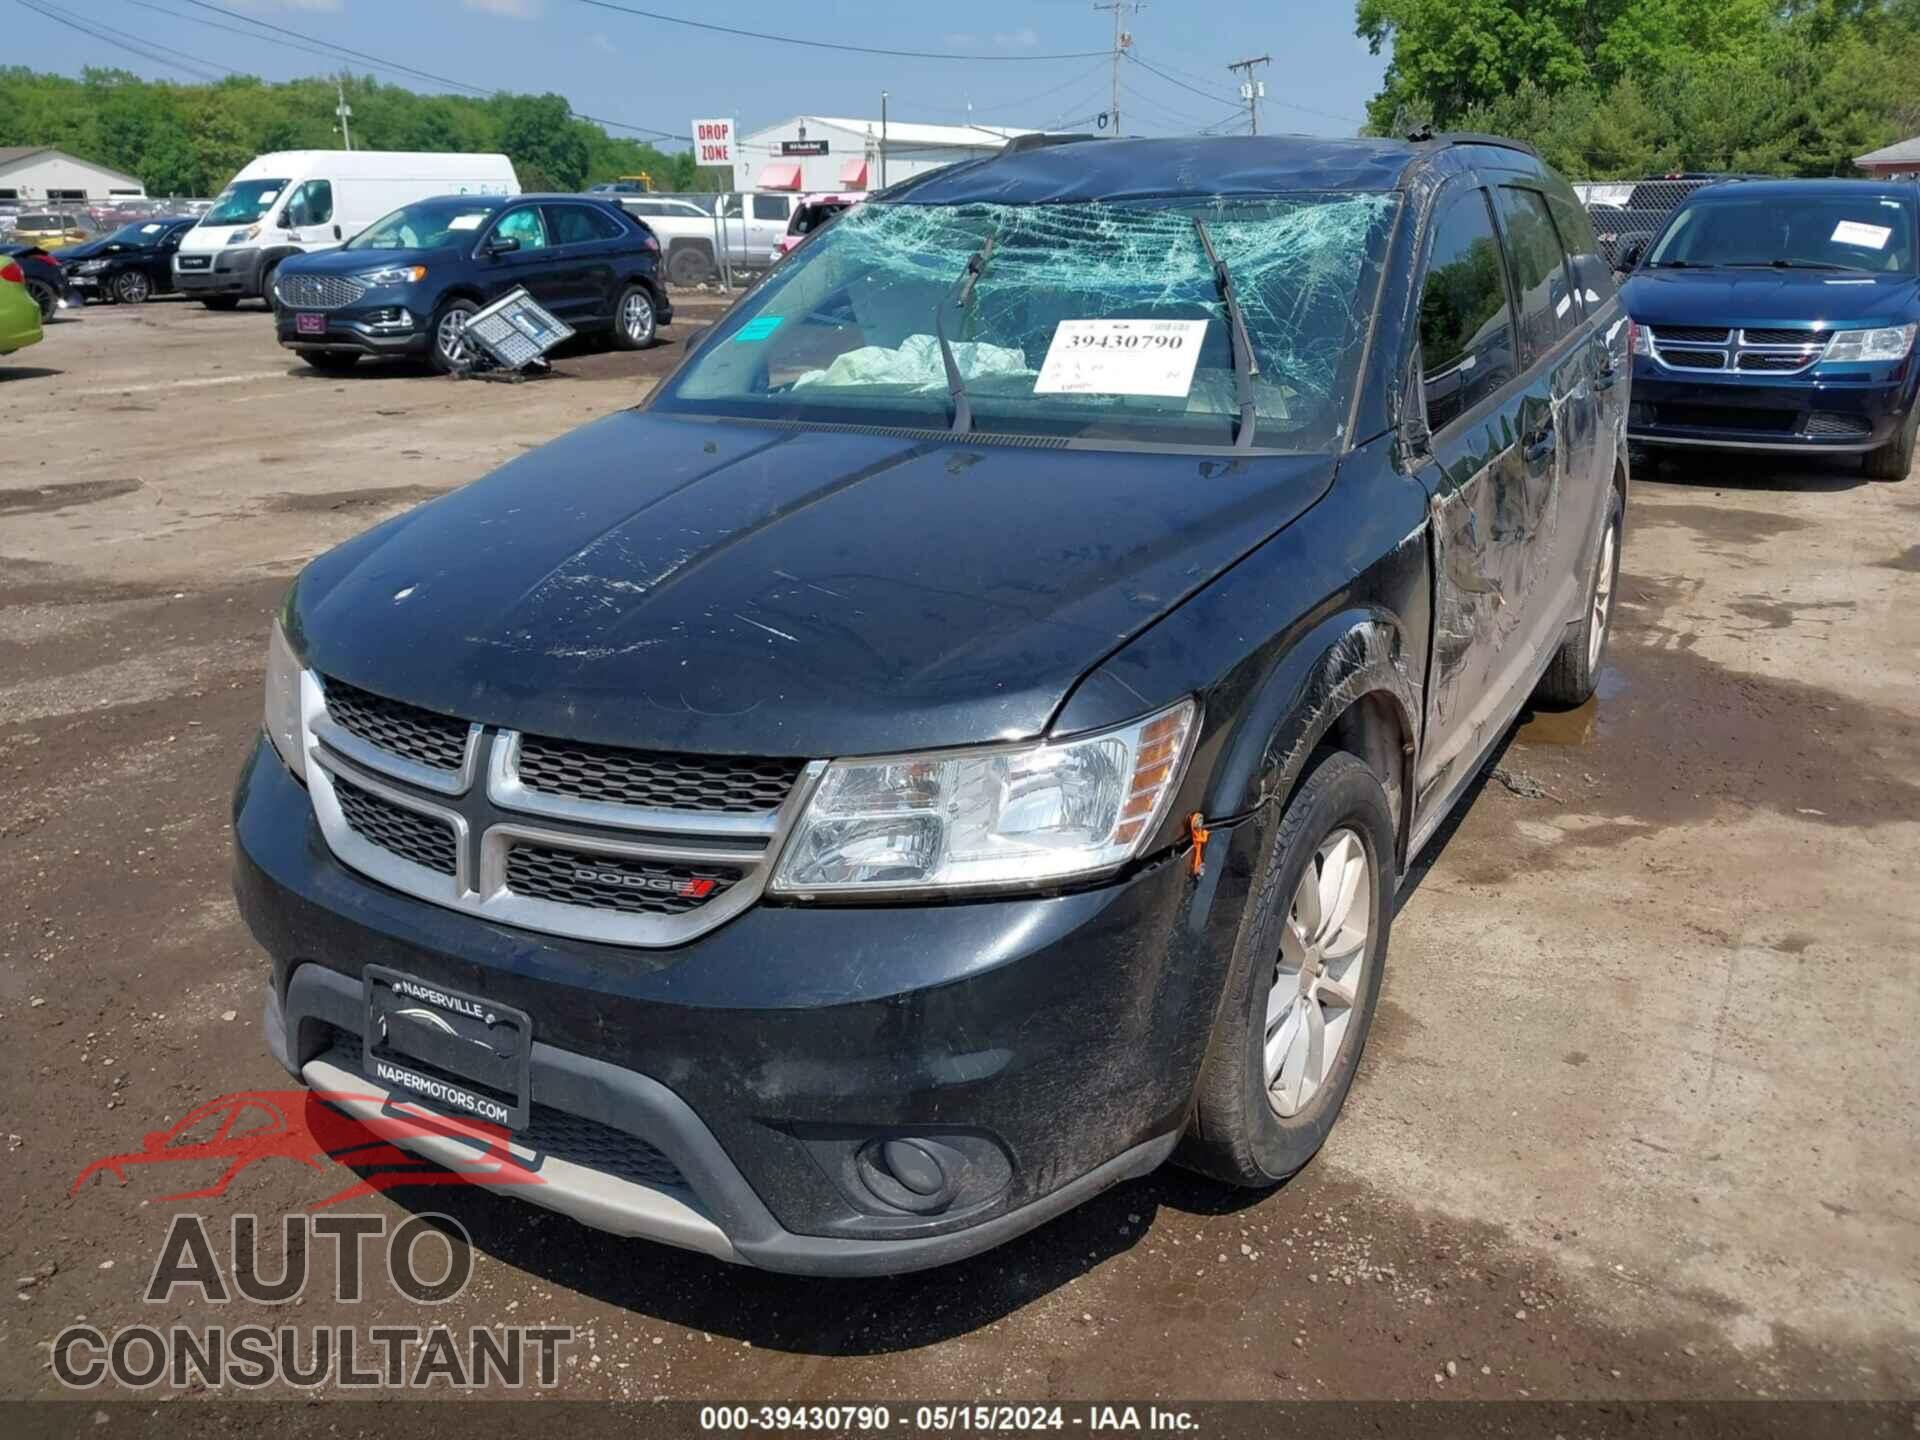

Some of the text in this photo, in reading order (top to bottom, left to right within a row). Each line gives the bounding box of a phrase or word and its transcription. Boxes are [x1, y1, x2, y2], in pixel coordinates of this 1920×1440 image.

[698, 124, 728, 140] DROP
[702, 145, 729, 161] ZONE
[1065, 335, 1183, 350] 39430790
[575, 869, 695, 893] DODGE
[402, 981, 484, 1018] NAPERVILLE
[377, 1063, 508, 1124] NAPERMOTORS.COM
